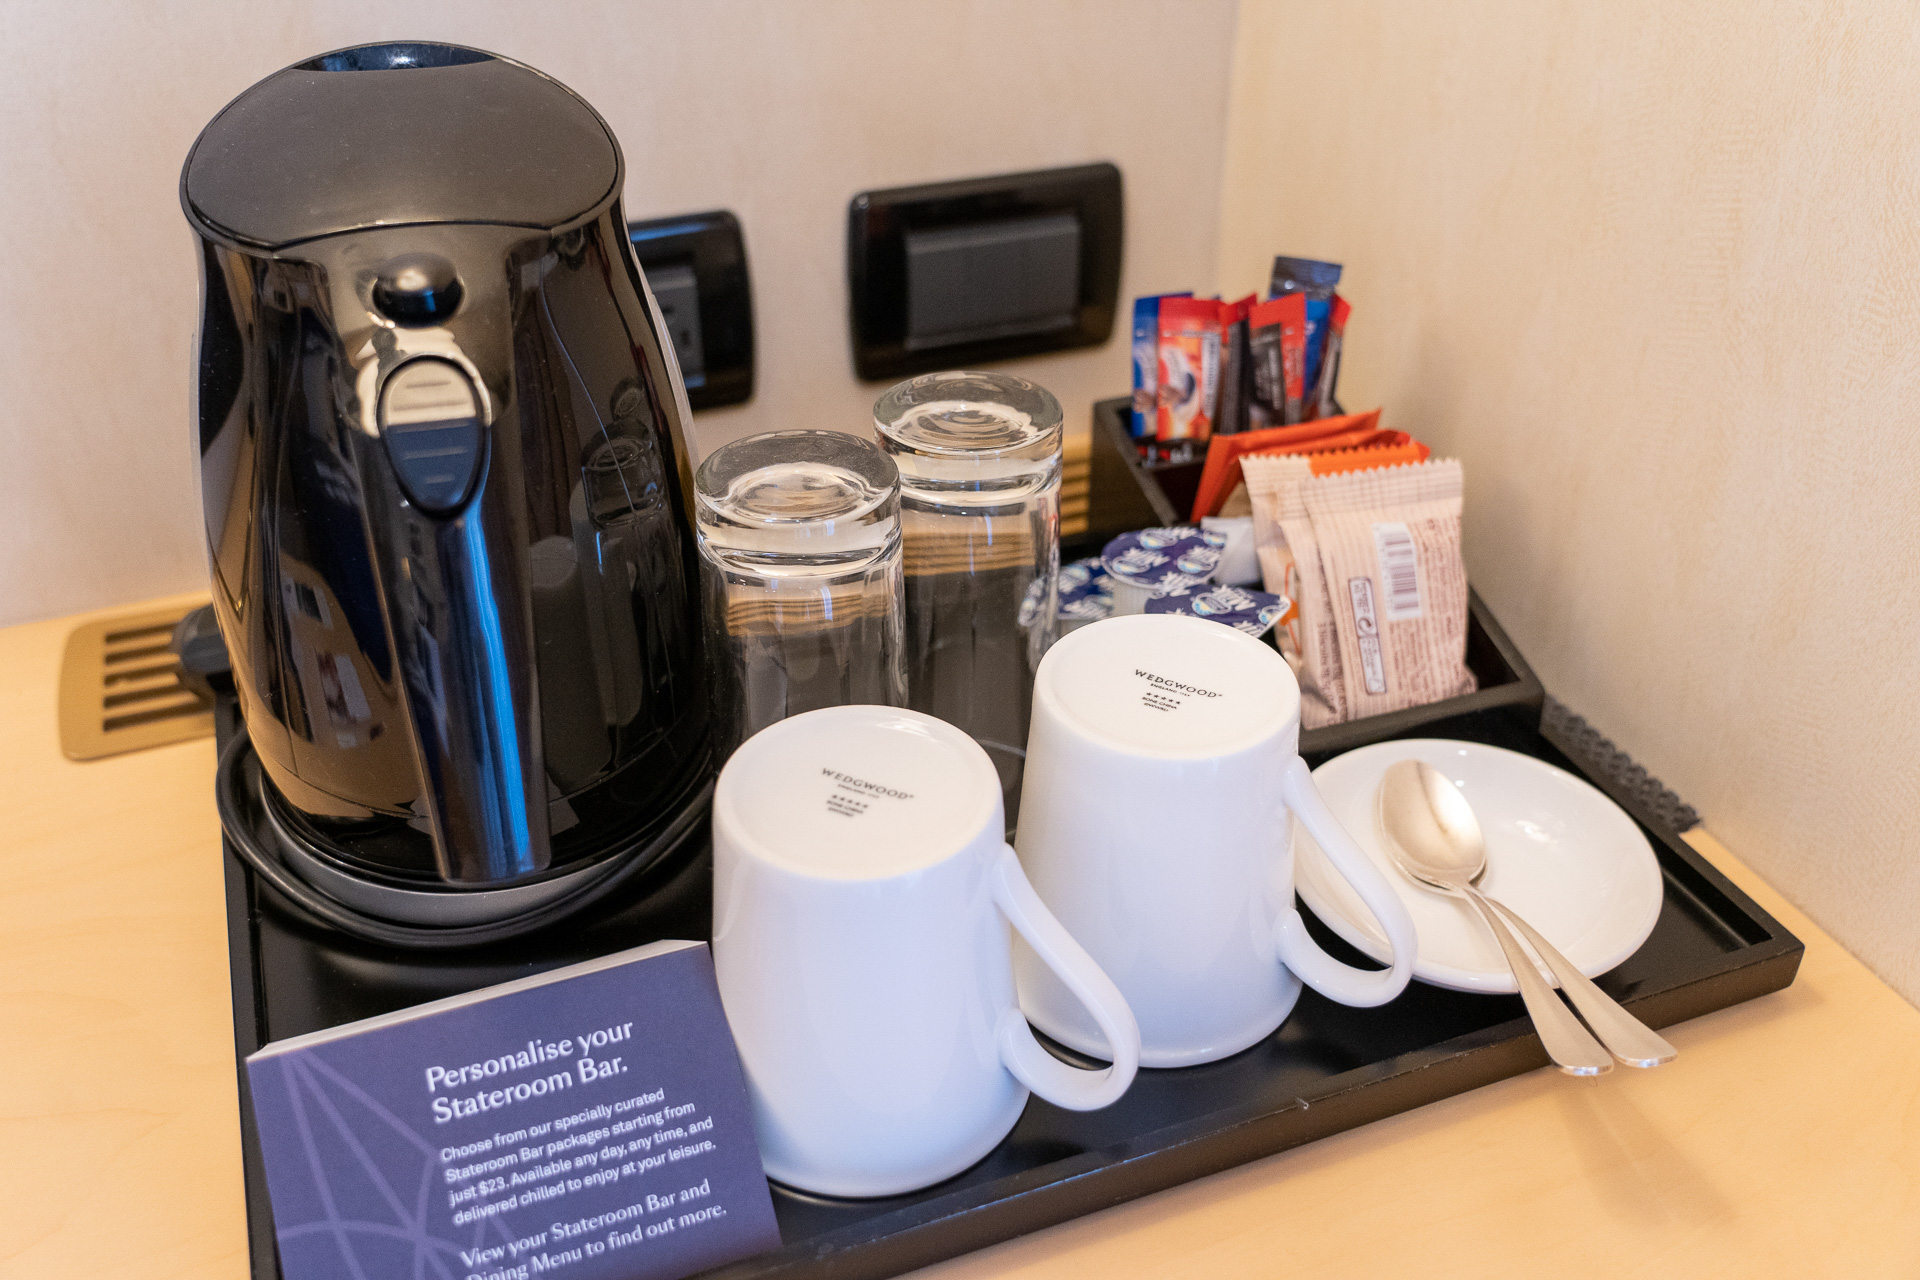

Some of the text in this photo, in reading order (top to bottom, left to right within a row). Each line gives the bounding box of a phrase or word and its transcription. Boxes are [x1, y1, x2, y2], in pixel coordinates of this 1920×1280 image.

[425, 1022, 634, 1093] Personalise your
[431, 1057, 628, 1124] Stateroom Bar.
[441, 1087, 665, 1162] Choose from our specially curated
[445, 1102, 696, 1183] Stateroom Bar packages starting from
[449, 1115, 713, 1209] just $23. Available any day, any time, and
[453, 1140, 717, 1225] delivered chilled to enjoy at your leisure.
[460, 1178, 711, 1268] View your Stateroom Bar and
[530, 1247, 583, 1273] Menu
[584, 1241, 605, 1257] to
[607, 1223, 643, 1250] find
[645, 1217, 676, 1237] out
[679, 1204, 727, 1228] more.
